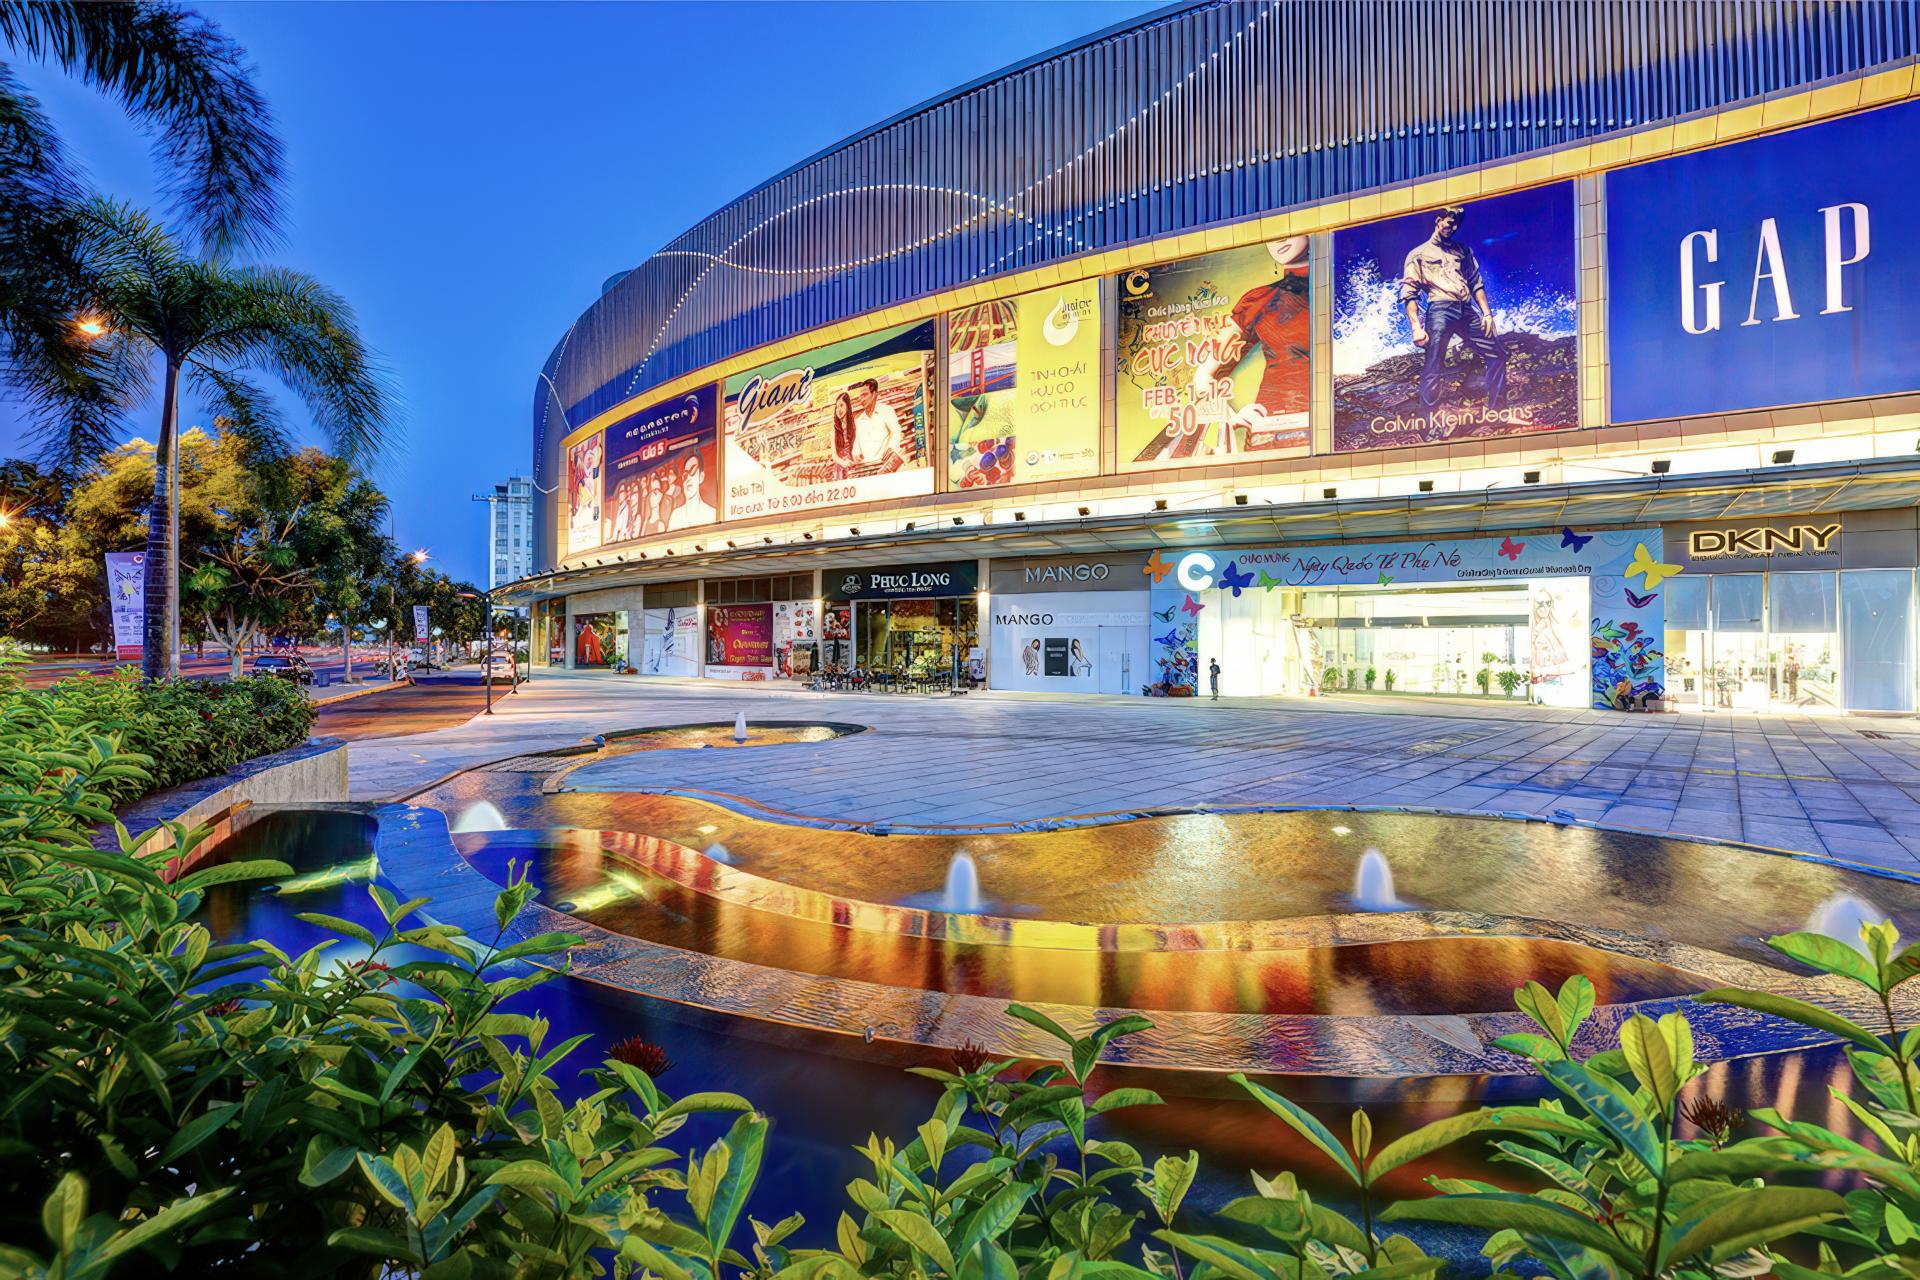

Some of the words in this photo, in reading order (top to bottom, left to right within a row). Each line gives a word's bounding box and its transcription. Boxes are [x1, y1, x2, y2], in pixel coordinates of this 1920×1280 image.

[1679, 201, 1872, 335] GAP
[739, 368, 814, 432] Giant
[1166, 403, 1198, 436] 50
[1370, 413, 1427, 434] Calvin
[1428, 410, 1475, 430] Klein
[1475, 404, 1534, 425] Jeans
[1692, 524, 1841, 553] DKNY
[911, 572, 951, 587] LONG
[1024, 562, 1110, 584] MANGO
[995, 613, 1054, 626] MANGO
